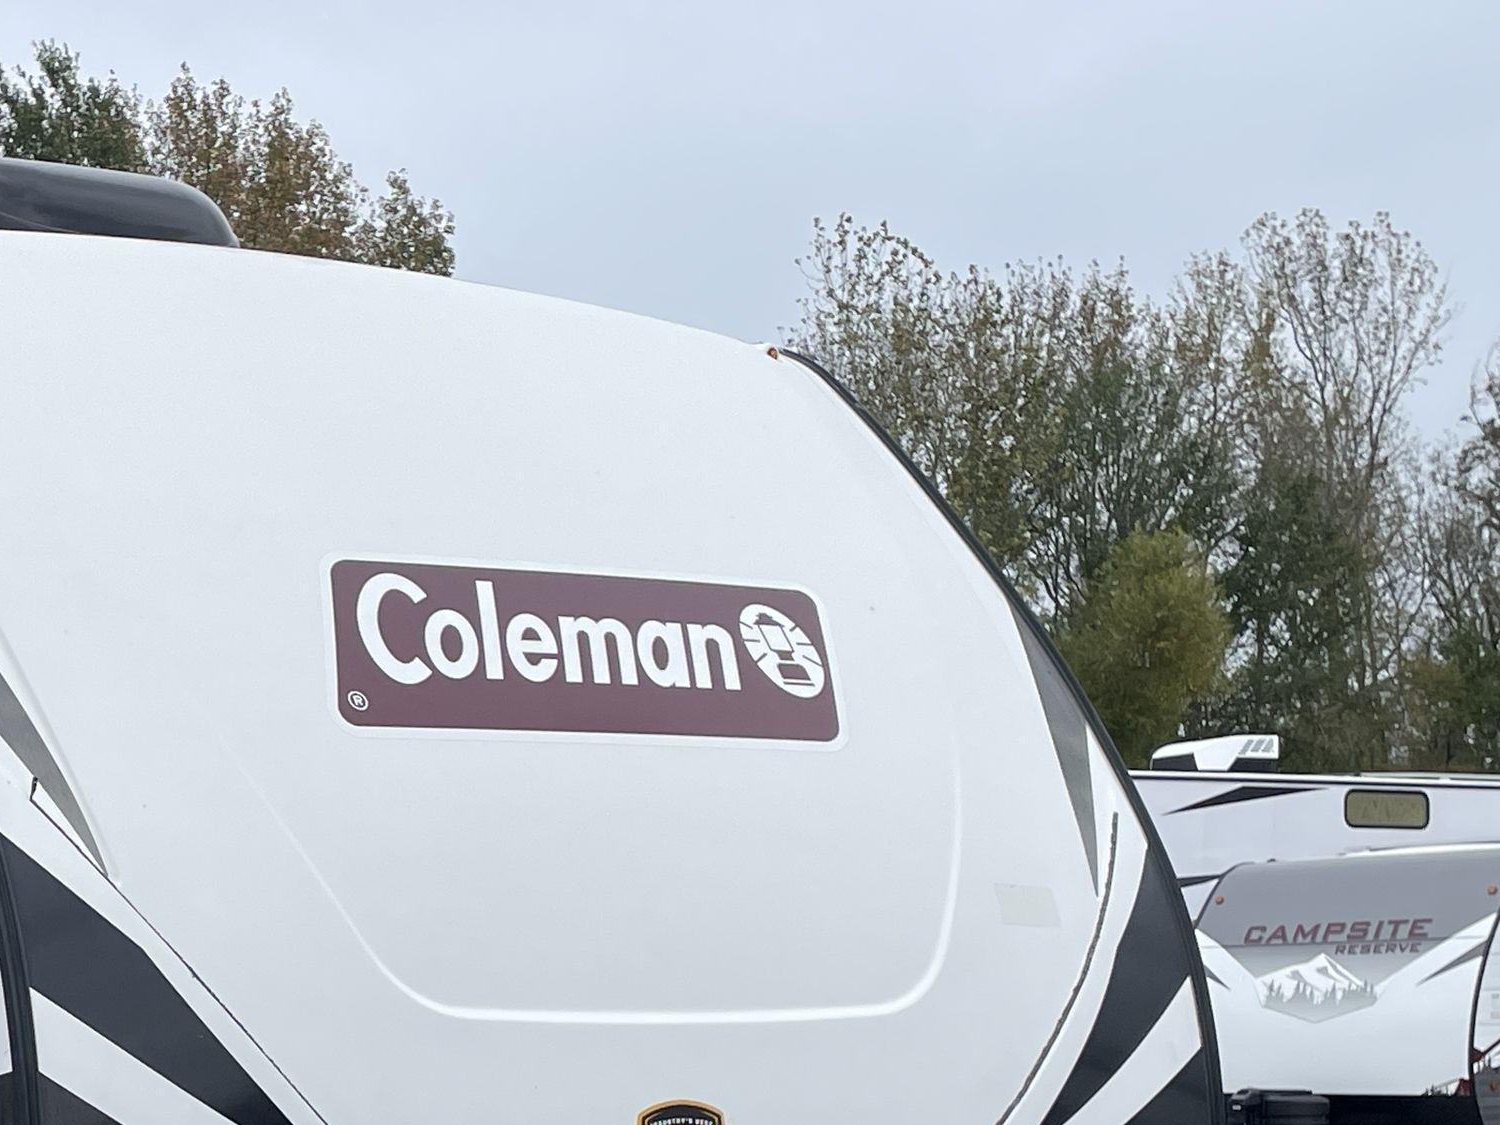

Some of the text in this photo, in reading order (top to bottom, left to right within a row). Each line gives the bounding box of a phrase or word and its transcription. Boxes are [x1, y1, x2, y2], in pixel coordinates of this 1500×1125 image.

[356, 572, 742, 691] Coleman
[1243, 918, 1433, 945] CAMPSITE
[1334, 942, 1422, 956] RESERVE
